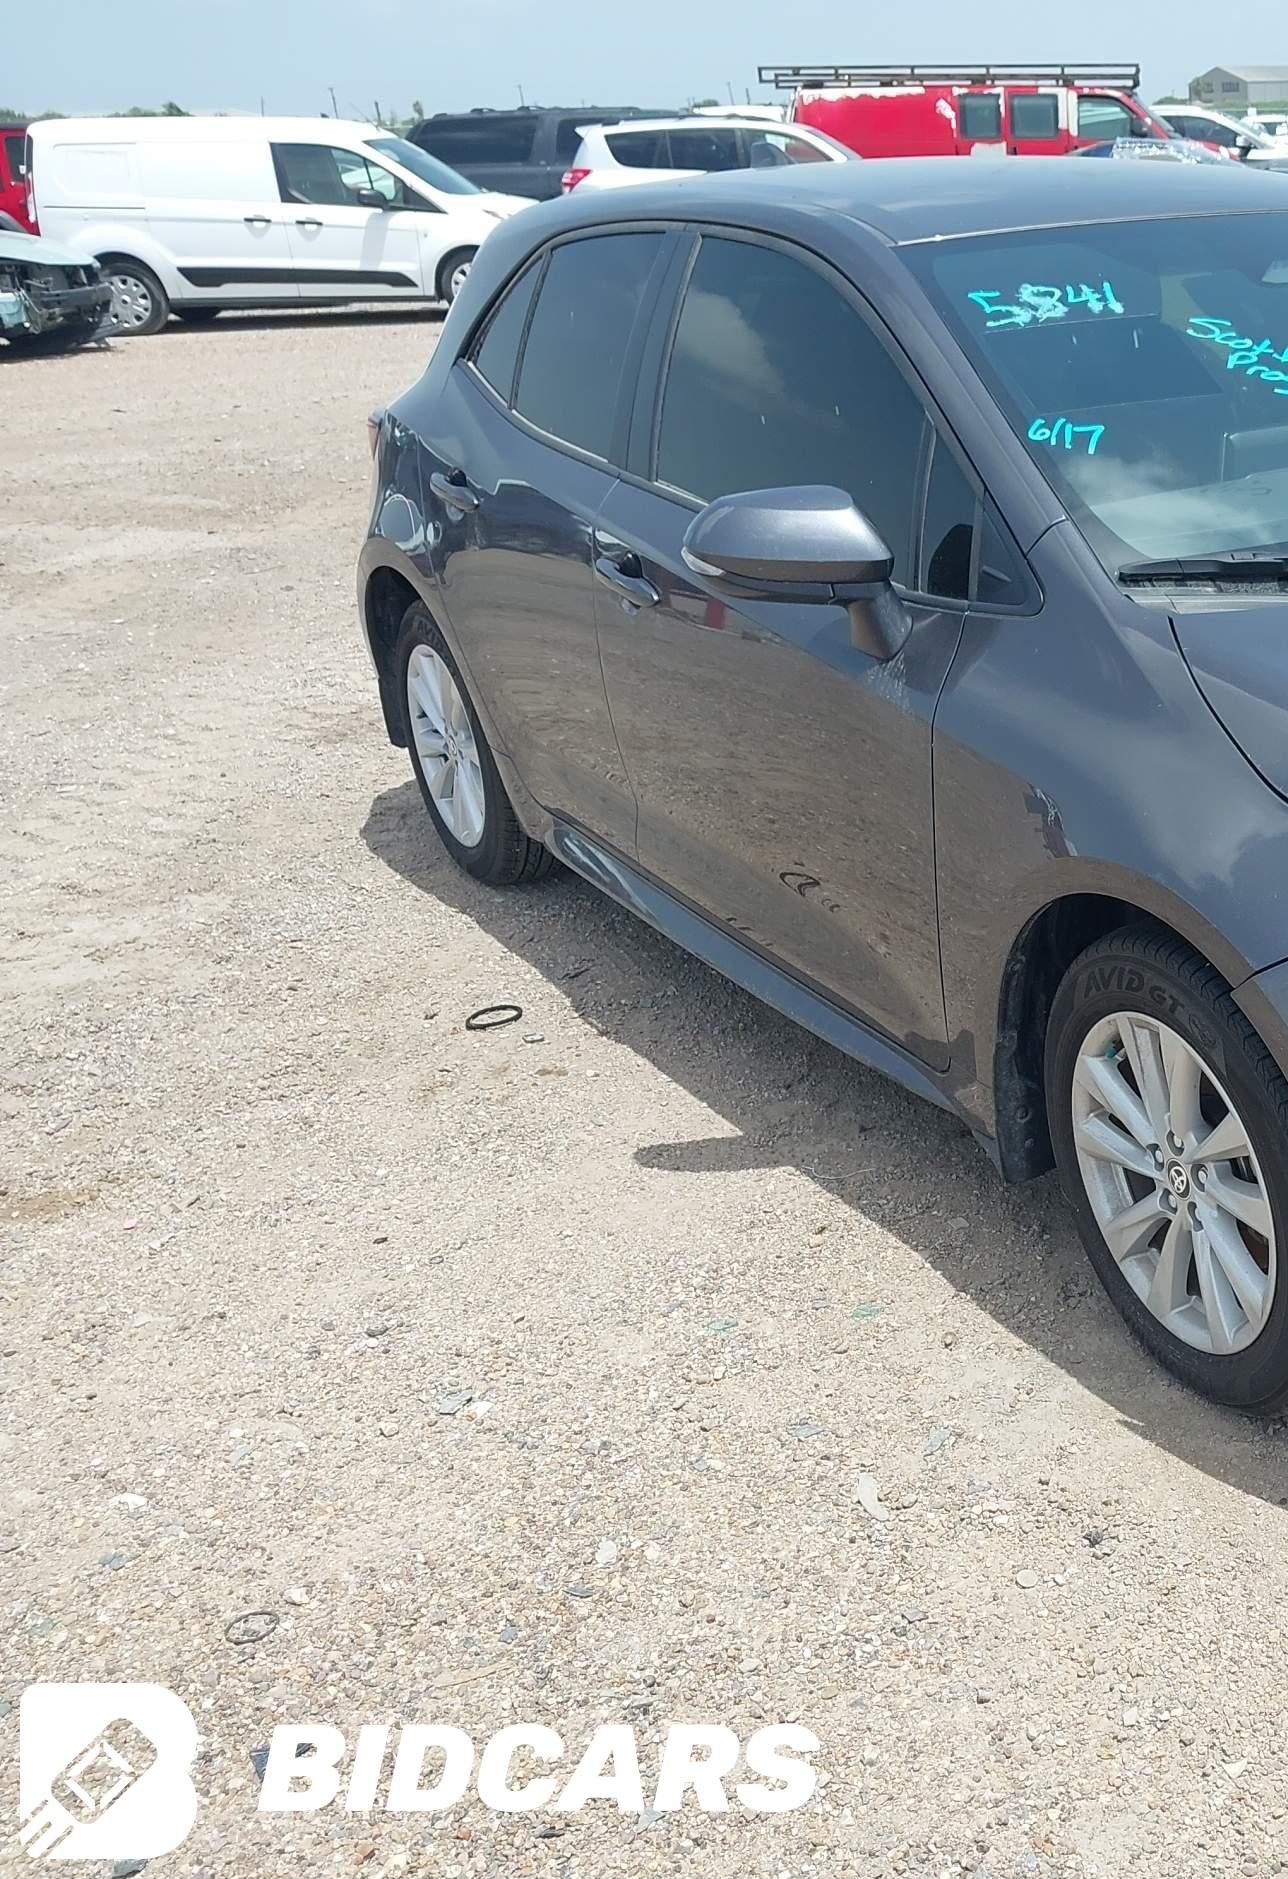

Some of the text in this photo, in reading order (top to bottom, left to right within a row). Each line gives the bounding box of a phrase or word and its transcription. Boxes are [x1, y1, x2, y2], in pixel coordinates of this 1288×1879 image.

[1027, 417, 1105, 455] 6/17
[1083, 964, 1185, 1014] AVID GT
